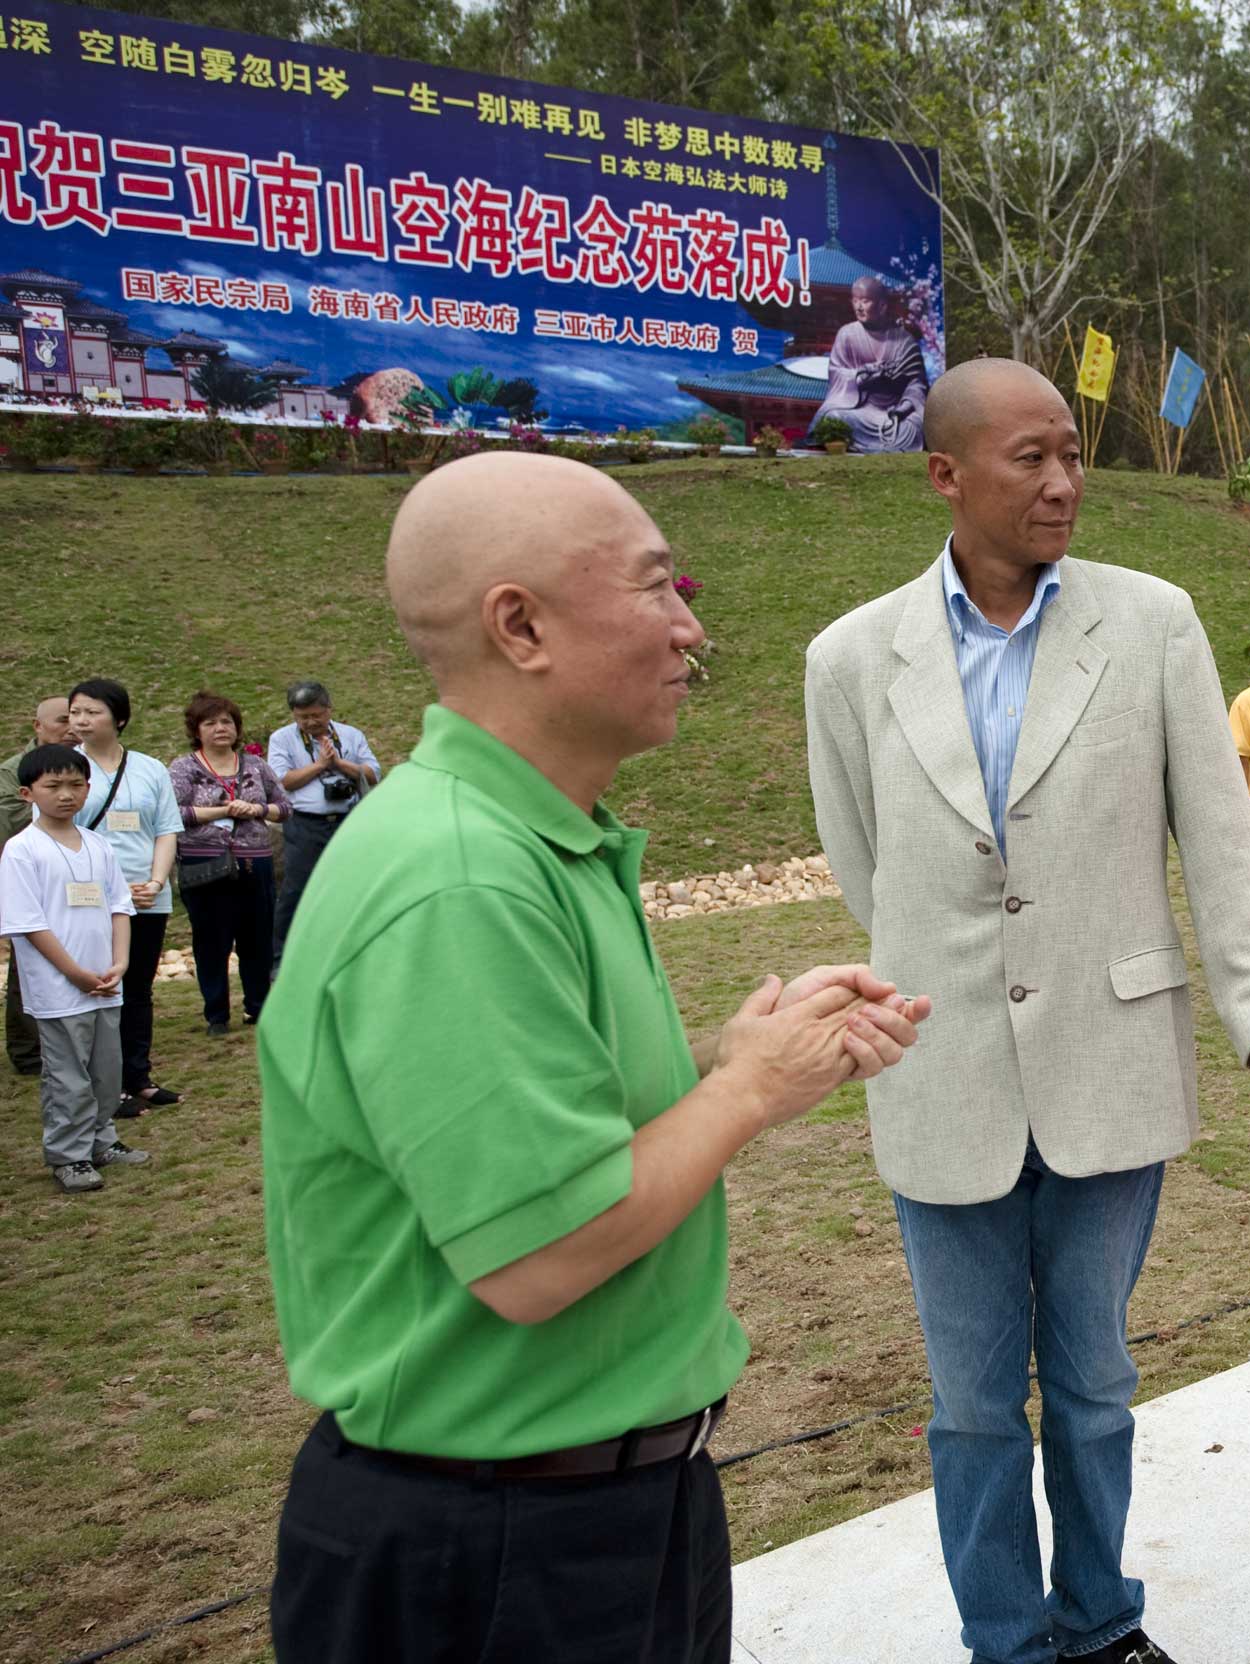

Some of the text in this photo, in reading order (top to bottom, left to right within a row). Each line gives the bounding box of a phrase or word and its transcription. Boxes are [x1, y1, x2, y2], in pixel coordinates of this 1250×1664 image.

[79, 29, 350, 100] 空随白雾忽归岑
[373, 83, 606, 140] 一生一别难再见
[624, 117, 826, 174] 非梦思中数数寻
[121, 268, 760, 356] 国家民宗局 海南省人民政府 三亚市人民政府 贺
